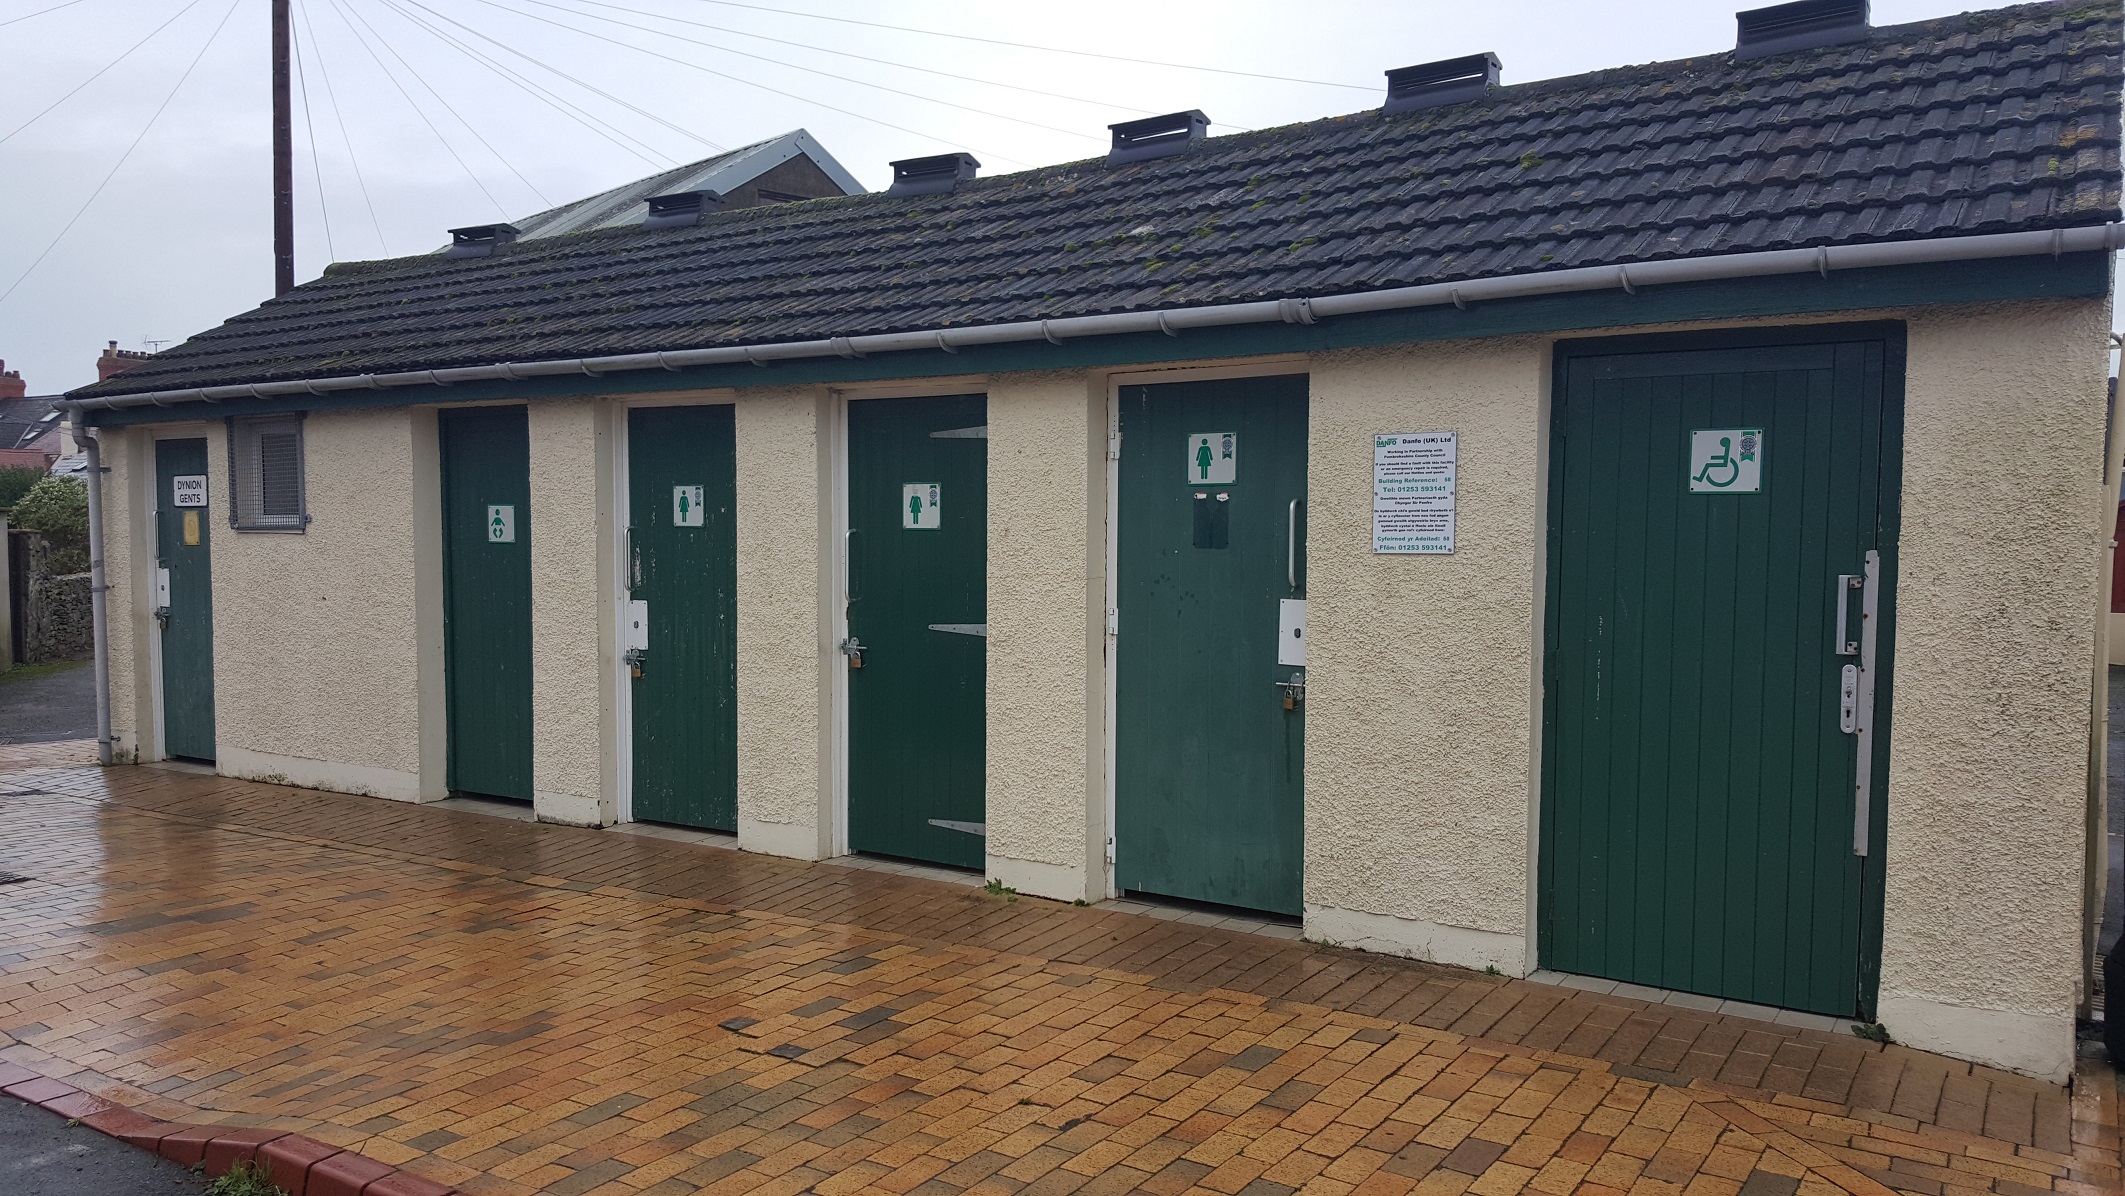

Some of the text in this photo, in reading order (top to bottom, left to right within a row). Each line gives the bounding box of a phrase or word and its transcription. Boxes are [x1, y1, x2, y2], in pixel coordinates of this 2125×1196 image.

[1376, 438, 1397, 447] DANFO
[178, 480, 202, 490] DYNION
[180, 494, 200, 503] GENTS
